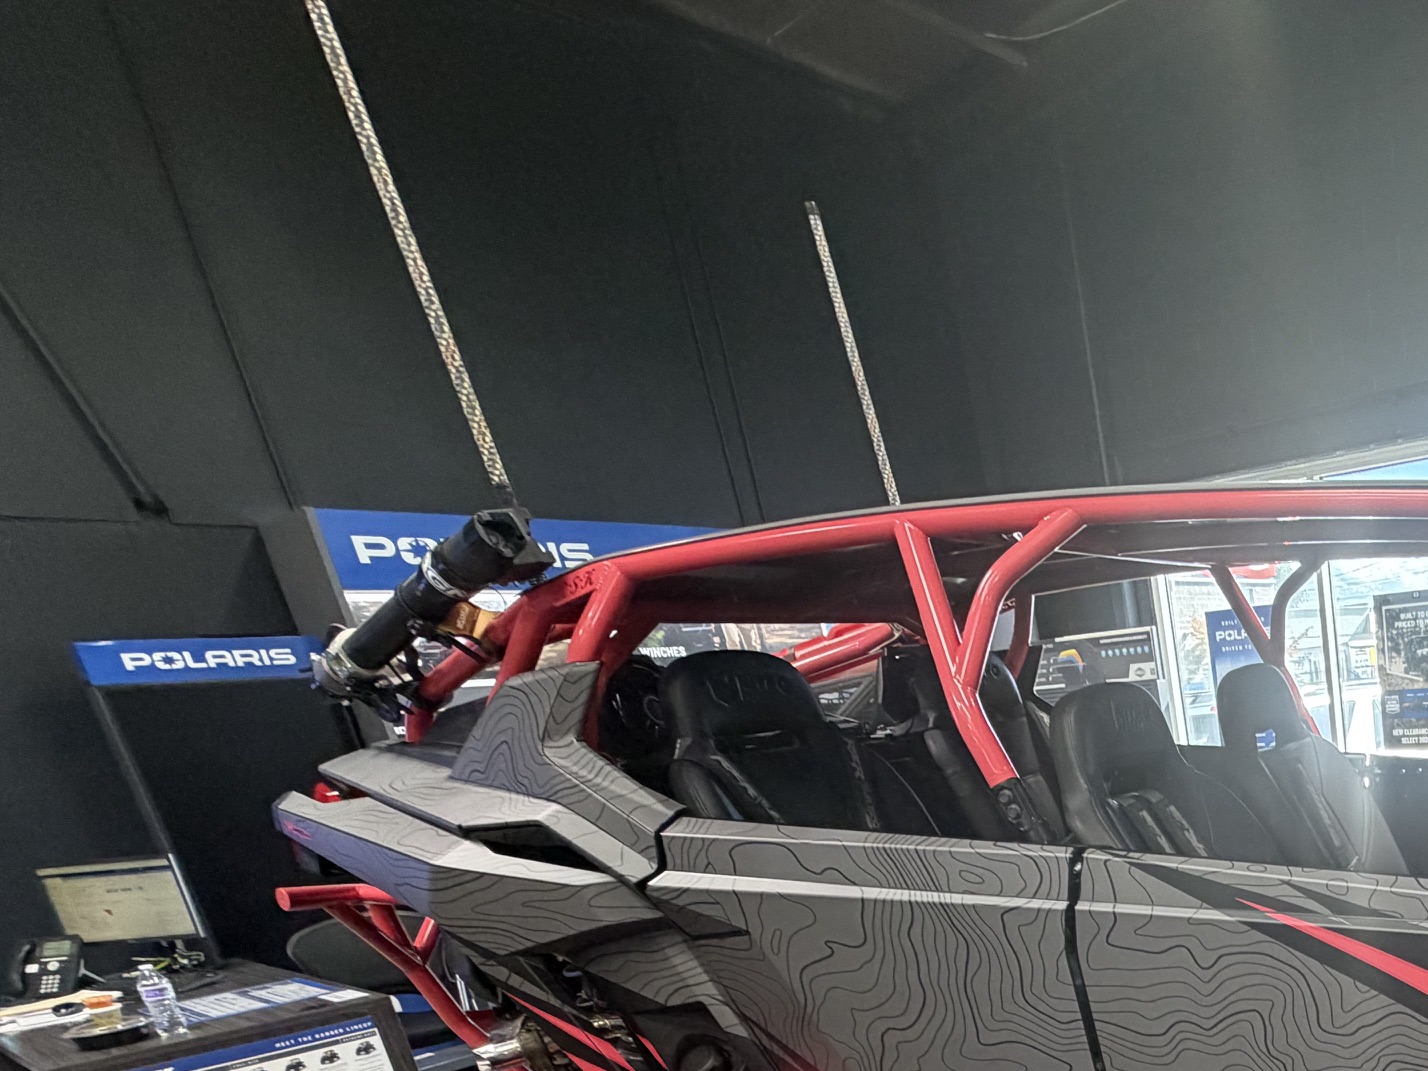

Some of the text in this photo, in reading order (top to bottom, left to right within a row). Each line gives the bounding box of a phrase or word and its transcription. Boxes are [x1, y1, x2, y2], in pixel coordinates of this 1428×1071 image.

[350, 534, 595, 568] POIS
[119, 648, 297, 671] POLARIS
[639, 646, 687, 658] WINCHES
[275, 1040, 295, 1048] MEET
[297, 1035, 312, 1043] THE
